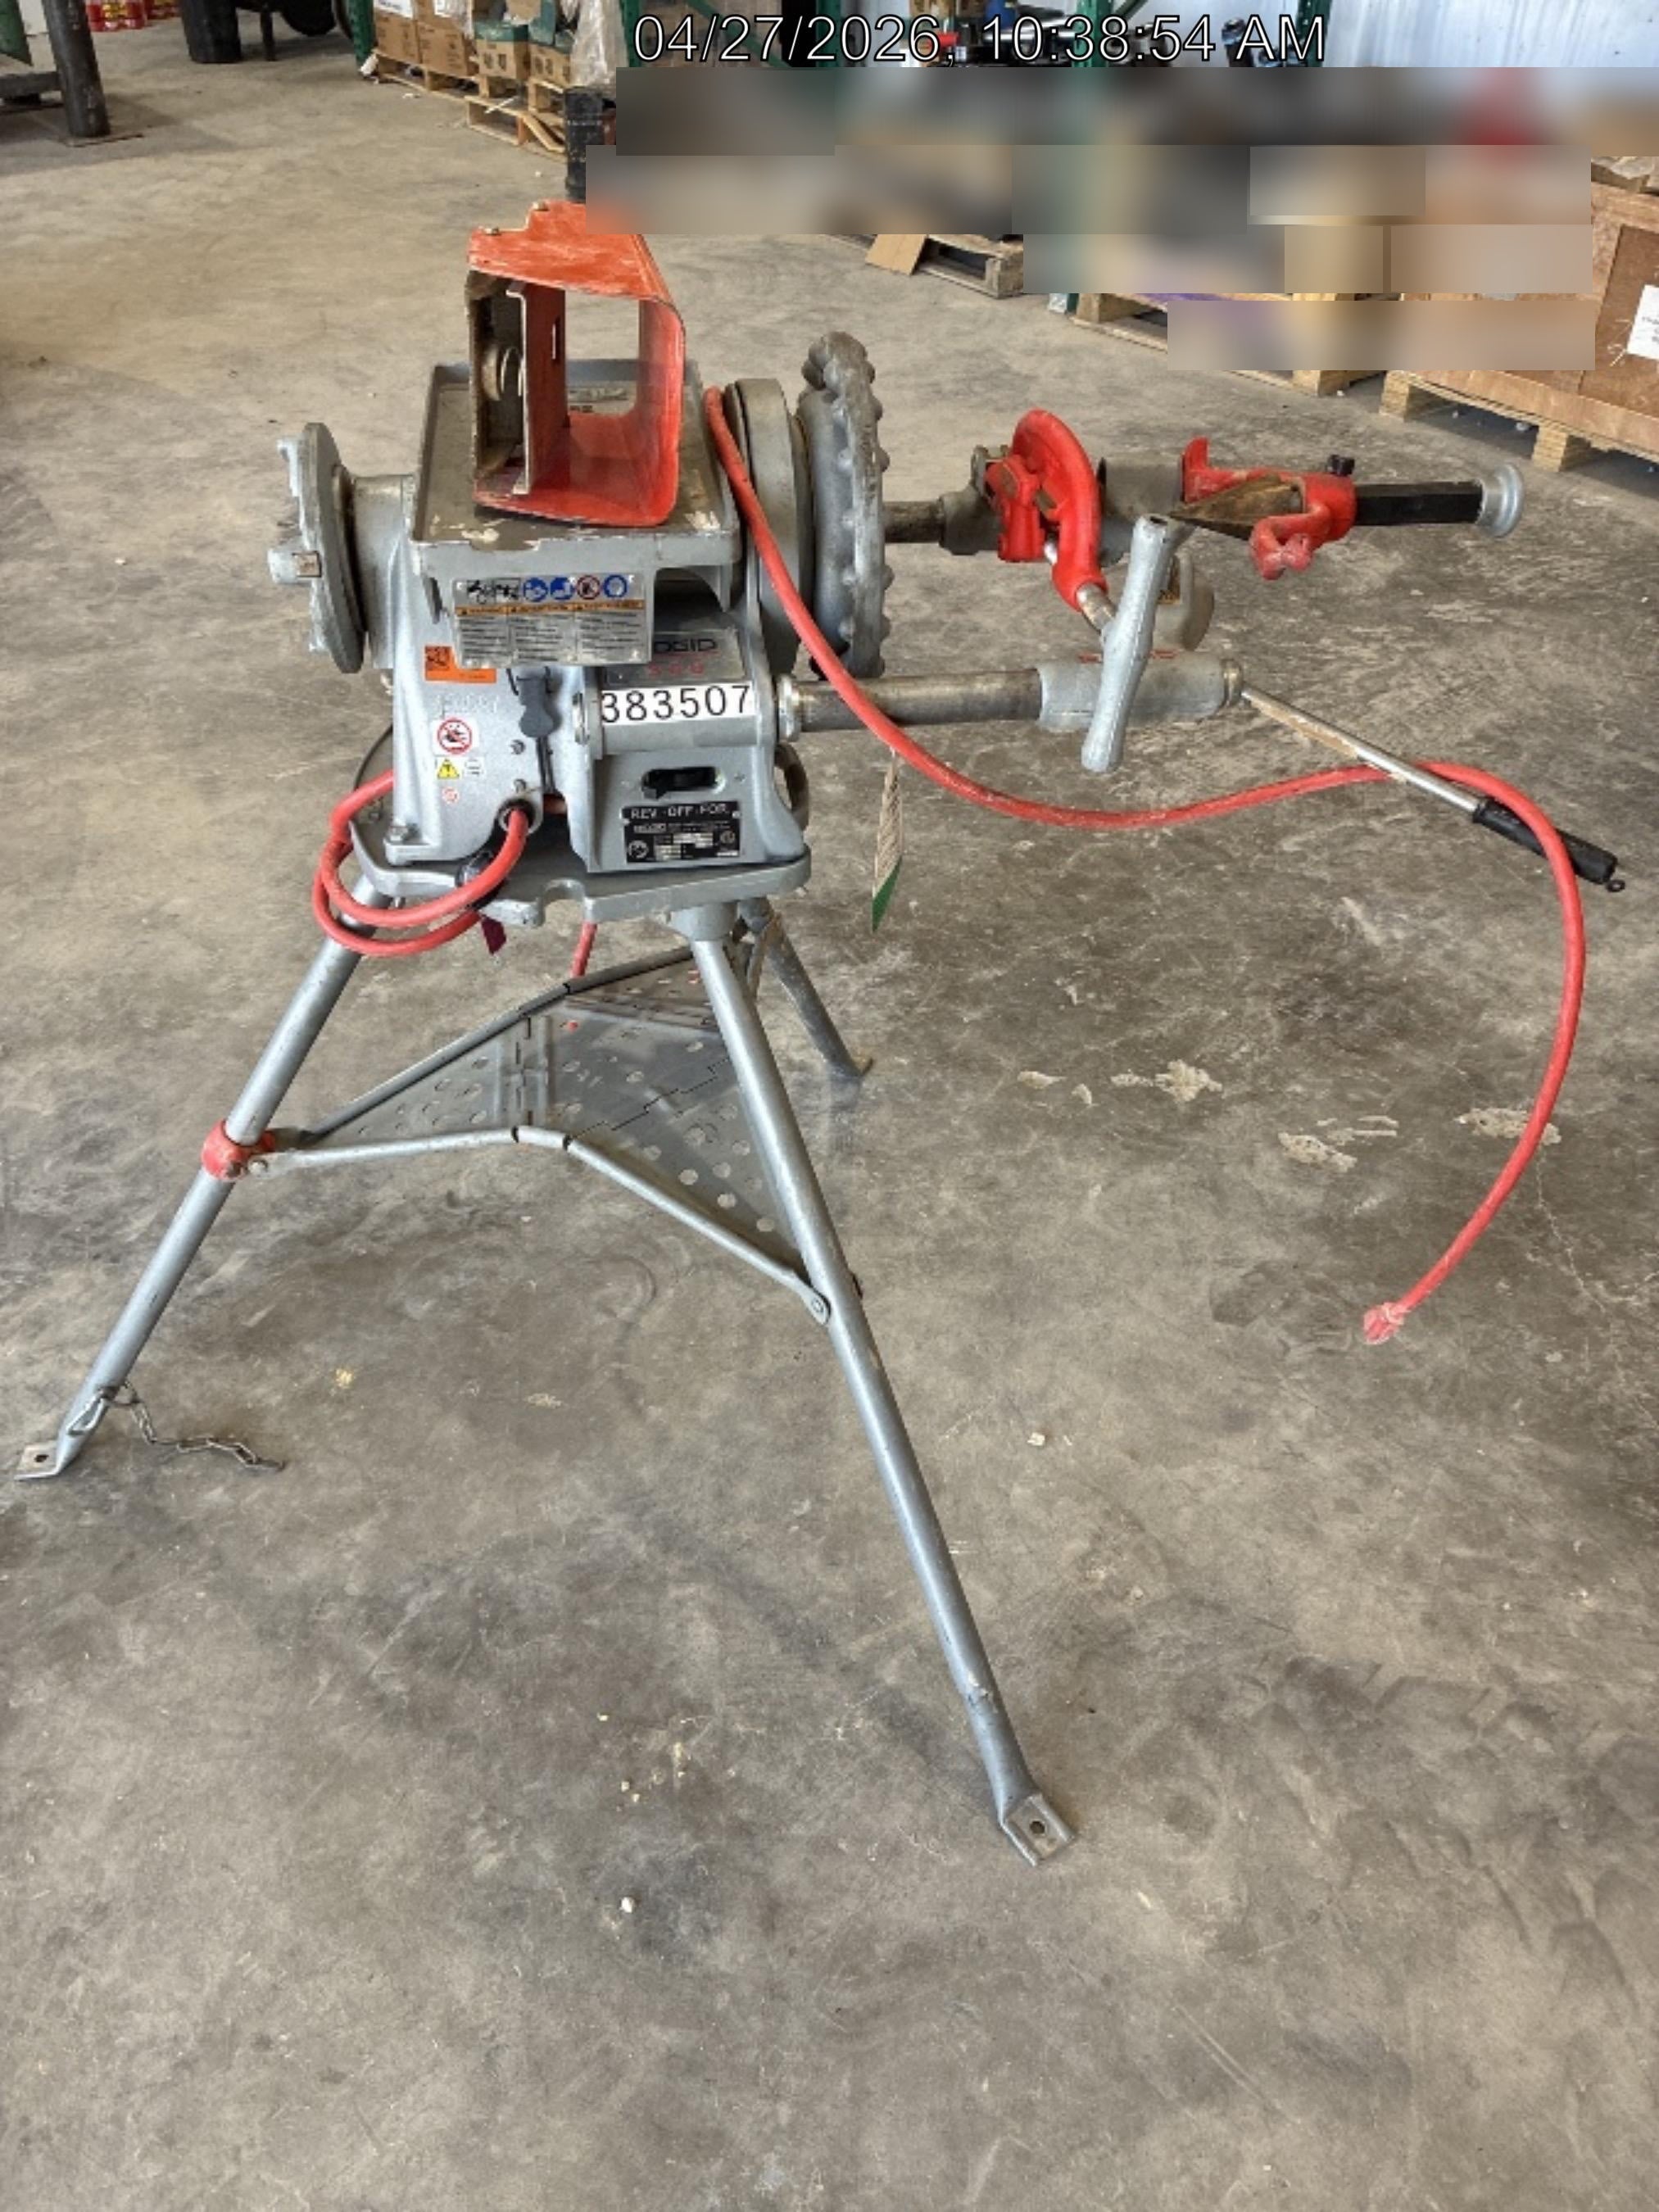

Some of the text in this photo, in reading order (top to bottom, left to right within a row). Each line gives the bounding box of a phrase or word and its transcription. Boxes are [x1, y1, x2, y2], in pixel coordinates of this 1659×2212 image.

[602, 685, 750, 723] 383507
[630, 808, 657, 819] REV
[668, 805, 694, 817] OFF
